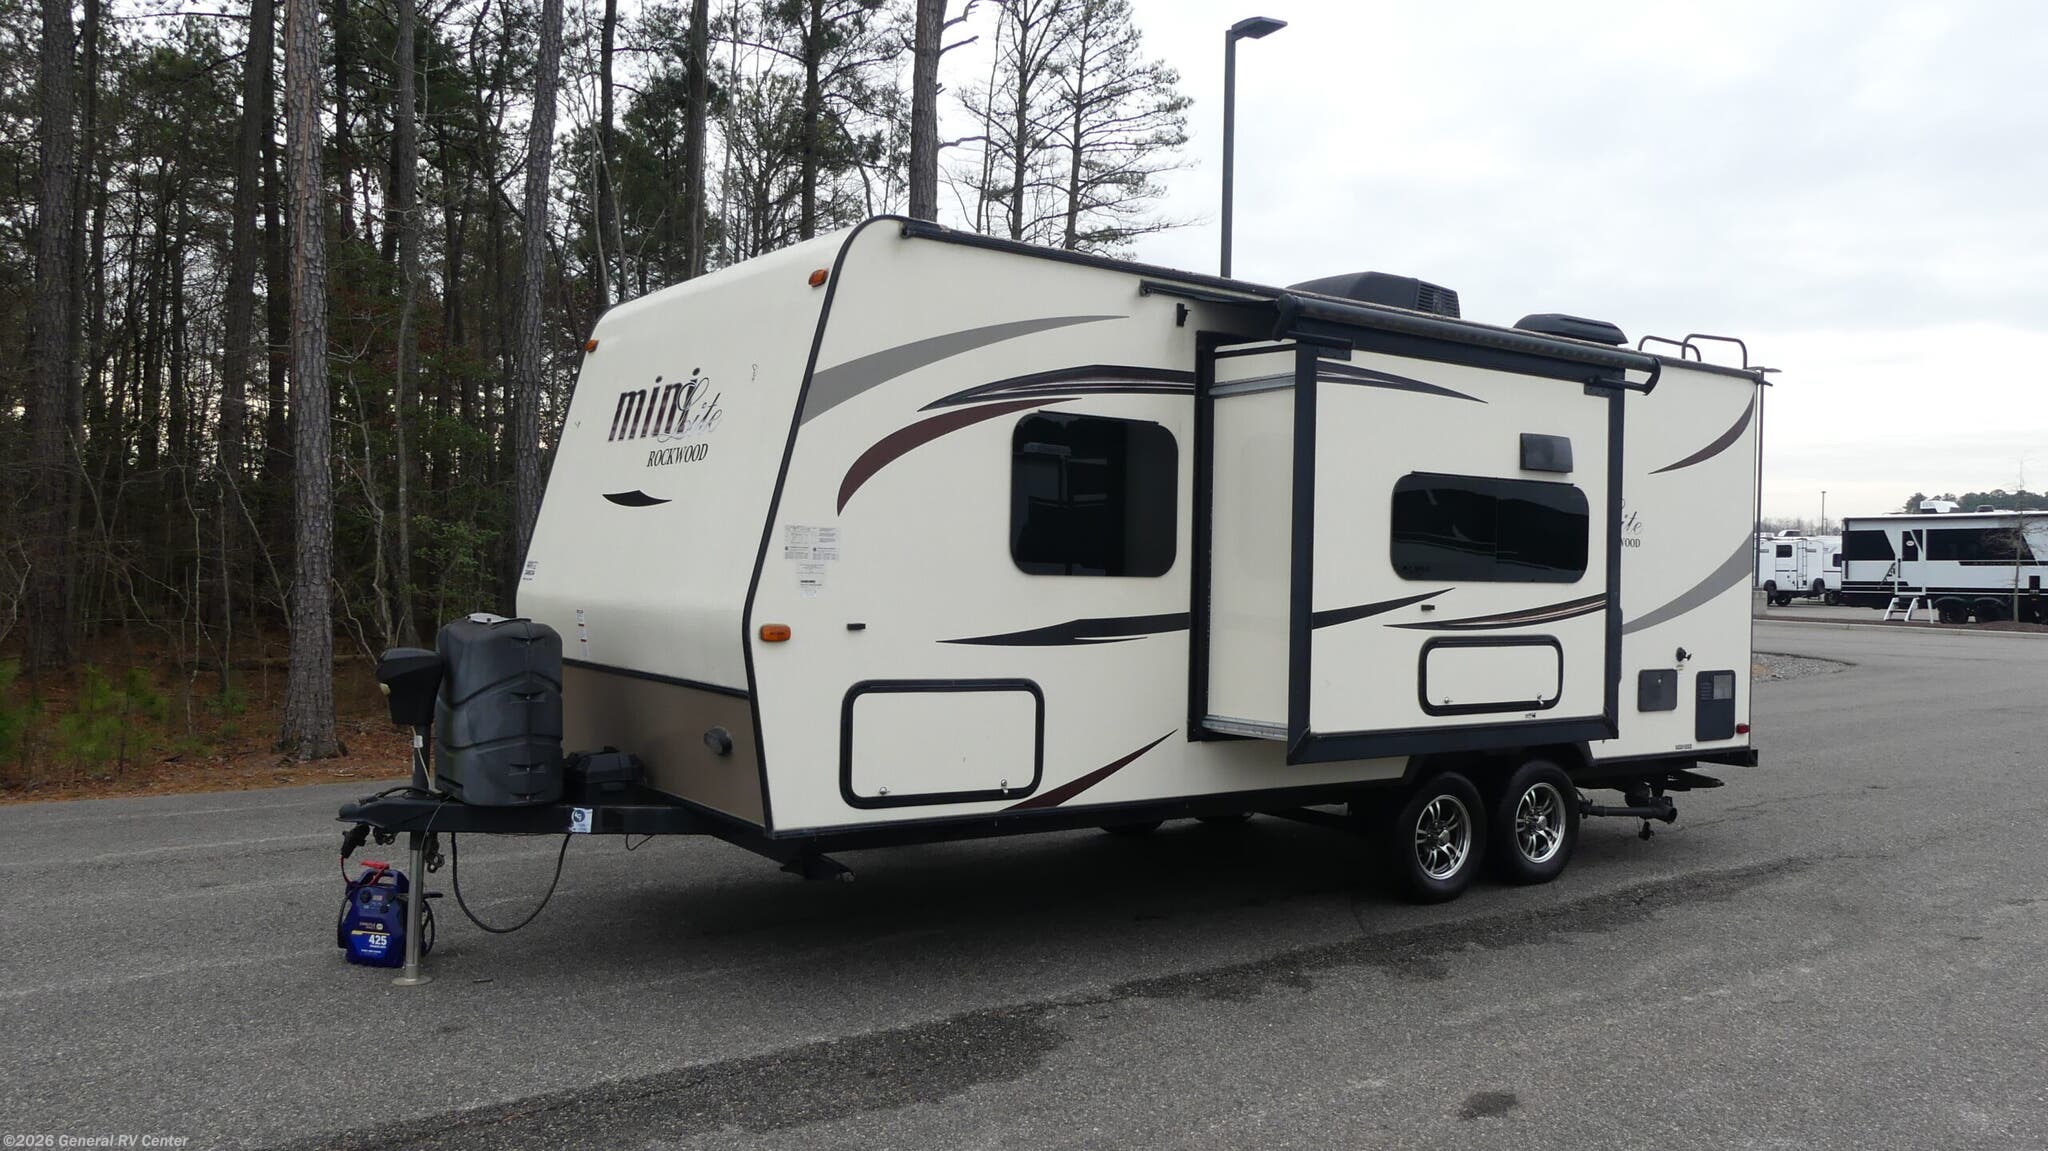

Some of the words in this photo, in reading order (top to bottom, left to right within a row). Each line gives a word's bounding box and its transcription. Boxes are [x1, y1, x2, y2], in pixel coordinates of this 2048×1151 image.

[608, 368, 700, 442] mini
[657, 377, 723, 443] Lite
[647, 443, 709, 467] ROCKWOOD
[369, 935, 387, 945] 425
